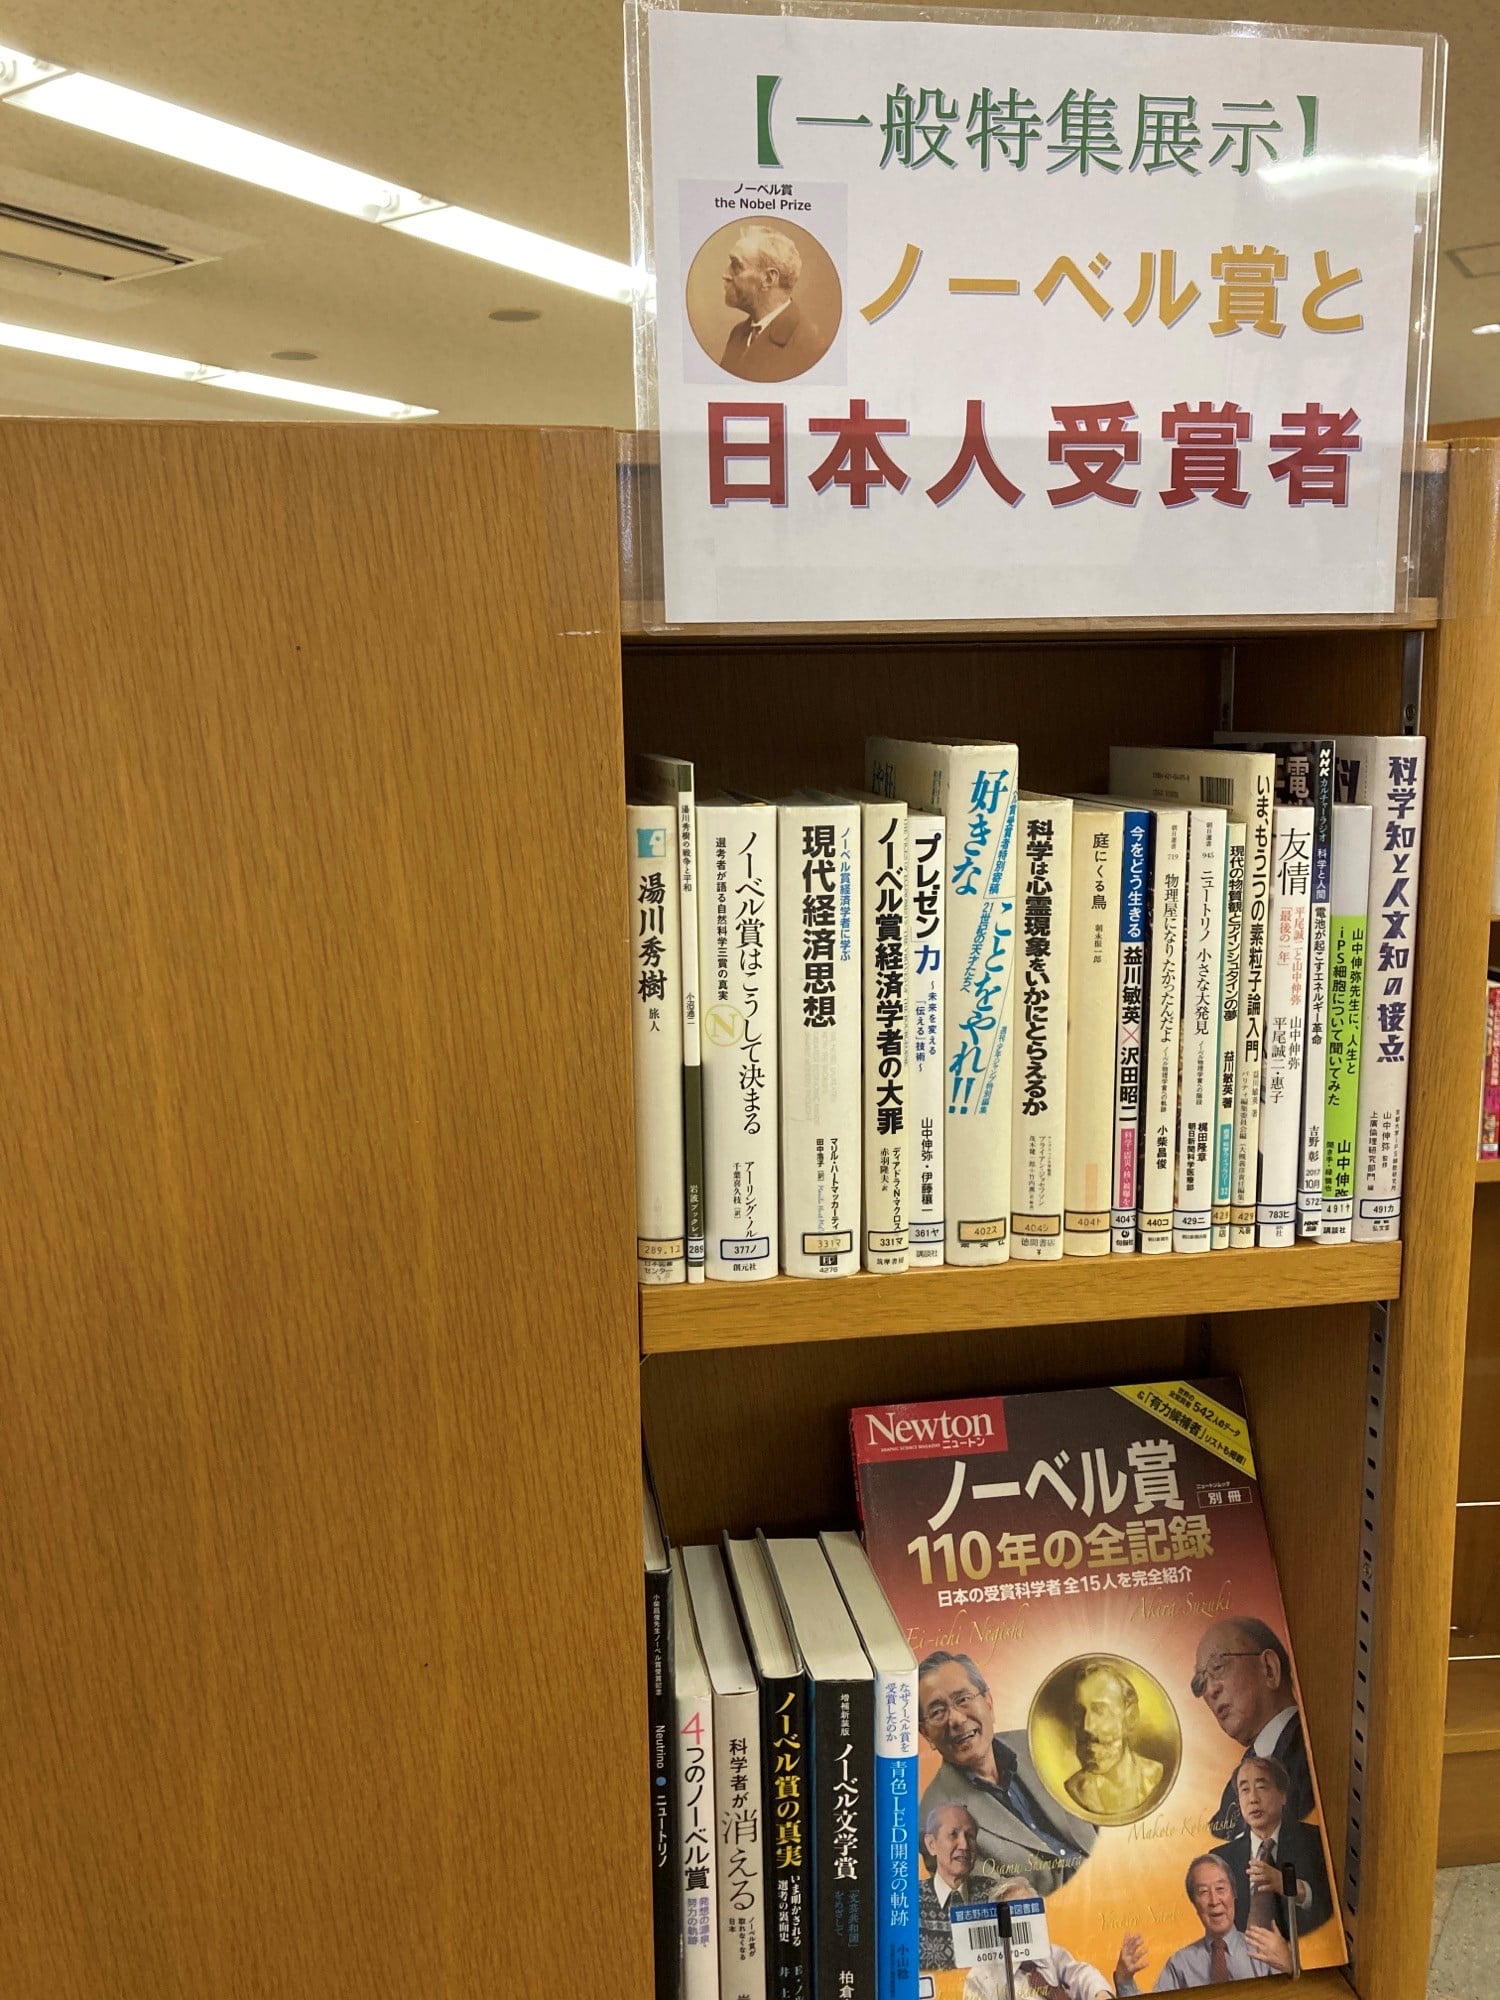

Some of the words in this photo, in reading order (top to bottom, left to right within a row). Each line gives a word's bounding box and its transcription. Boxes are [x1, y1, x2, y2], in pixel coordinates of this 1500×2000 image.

[756, 74, 1319, 176] 【一般特集展示】
[715, 197, 736, 208] the
[740, 198, 775, 209] Nobel
[780, 200, 811, 210] Prize
[734, 183, 793, 195] ノーベル賞
[859, 242, 1365, 338] ノーベル賞と
[705, 399, 1364, 508] 日本人受賞者
[1319, 749, 1331, 777] NHK
[951, 769, 1008, 896] 好きな
[1319, 779, 1329, 842] カルチャーラジオ
[681, 805, 692, 892] 湯川秀樹の戦争と平和
[1091, 833, 1110, 910] 庭にくる鳥
[1128, 826, 1145, 938] 今をどう生きる
[1277, 827, 1311, 896] 友情
[1316, 848, 1328, 900] 科学と人間
[715, 837, 729, 1001] 選考者が語る自然科学三賞の真実
[802, 825, 836, 1028] 現代経済思想
[839, 828, 851, 961] ノーベル賞経済学者に学ぶ
[914, 832, 942, 975] プレゼン力
[1200, 870, 1215, 942] ニュートリノ
[1245, 775, 1270, 1063] いま、もう一つの素粒子論入門
[1376, 756, 1418, 1063] 科学知と人文知の接点
[638, 872, 668, 1002] 湯川秀樹
[960, 902, 994, 994] 21世紀の天才たちへ
[1022, 819, 1054, 1116] 科学は心霊現象をいかにとらえるか
[1093, 924, 1103, 963] 朝永振一郎
[1160, 874, 1179, 1043] 物理屋になりたかったんだよ
[1224, 846, 1246, 1021] 現代の物質観とアインシュタインの夢
[1291, 907, 1305, 1006] 平尾誠二と山中伸弥
[735, 831, 766, 1135] ノーベル賞はこうして決まる
[875, 818, 904, 1135] ノーベル賞経済学者の大罪
[1195, 947, 1211, 1035] 小さな大発見
[1312, 907, 1326, 1045] 電池が起こすエネルギー革命
[1345, 928, 1364, 1074] 山中伸弥先生に、人生と
[648, 1008, 661, 1032] 旅人
[1119, 946, 1144, 1122] 益川敏英×沢田昭二
[1288, 1016, 1302, 1070] 山中伸弥
[1327, 926, 1347, 1106] iPS細胞について聞いてみた
[1222, 1051, 1236, 1095] 益川敏英
[1157, 1125, 1168, 1170] 小柴昌俊
[1197, 1122, 1208, 1162] 梶田隆章
[1308, 1150, 1319, 1162] 彰
[1309, 1126, 1319, 1147] 吉野
[1382, 1111, 1391, 1151] 山中伸弥
[1305, 1180, 1320, 1189] 10月
[880, 1238, 904, 1247] 331マ
[1021, 1238, 1056, 1247] 徳間書店
[865, 1410, 995, 1446] Newton
[942, 1437, 985, 1449] ニュートン
[927, 1438, 1185, 1533] ノーベル賞
[1208, 1489, 1242, 1505] 別冊
[906, 1514, 1215, 1586] 110年の全記録
[654, 1725, 665, 1769] Neutrino
[840, 1693, 851, 1736] 増補新装版
[885, 1684, 898, 1742] 受賞したのか
[899, 1683, 911, 1753] なぜノーベル賞を
[680, 1711, 710, 1892] 4つのノーベル賞
[773, 1691, 804, 1869] ノーベル賞の真実
[832, 1742, 860, 1881] ノーベル文学賞
[655, 1795, 668, 1868] ニュートリノ
[721, 1737, 759, 1911] 科学者が消える
[889, 1761, 909, 1927] 青色LED開発の軌跡
[729, 1918, 736, 1932] 日本
[777, 1879, 789, 1942] 選考の裏面史
[790, 1874, 802, 1948] いま明かされる
[955, 1902, 1041, 1921] 習志野市立図書館
[839, 1970, 855, 2000] 柏倉
[977, 1948, 1030, 1962] 600760-0
